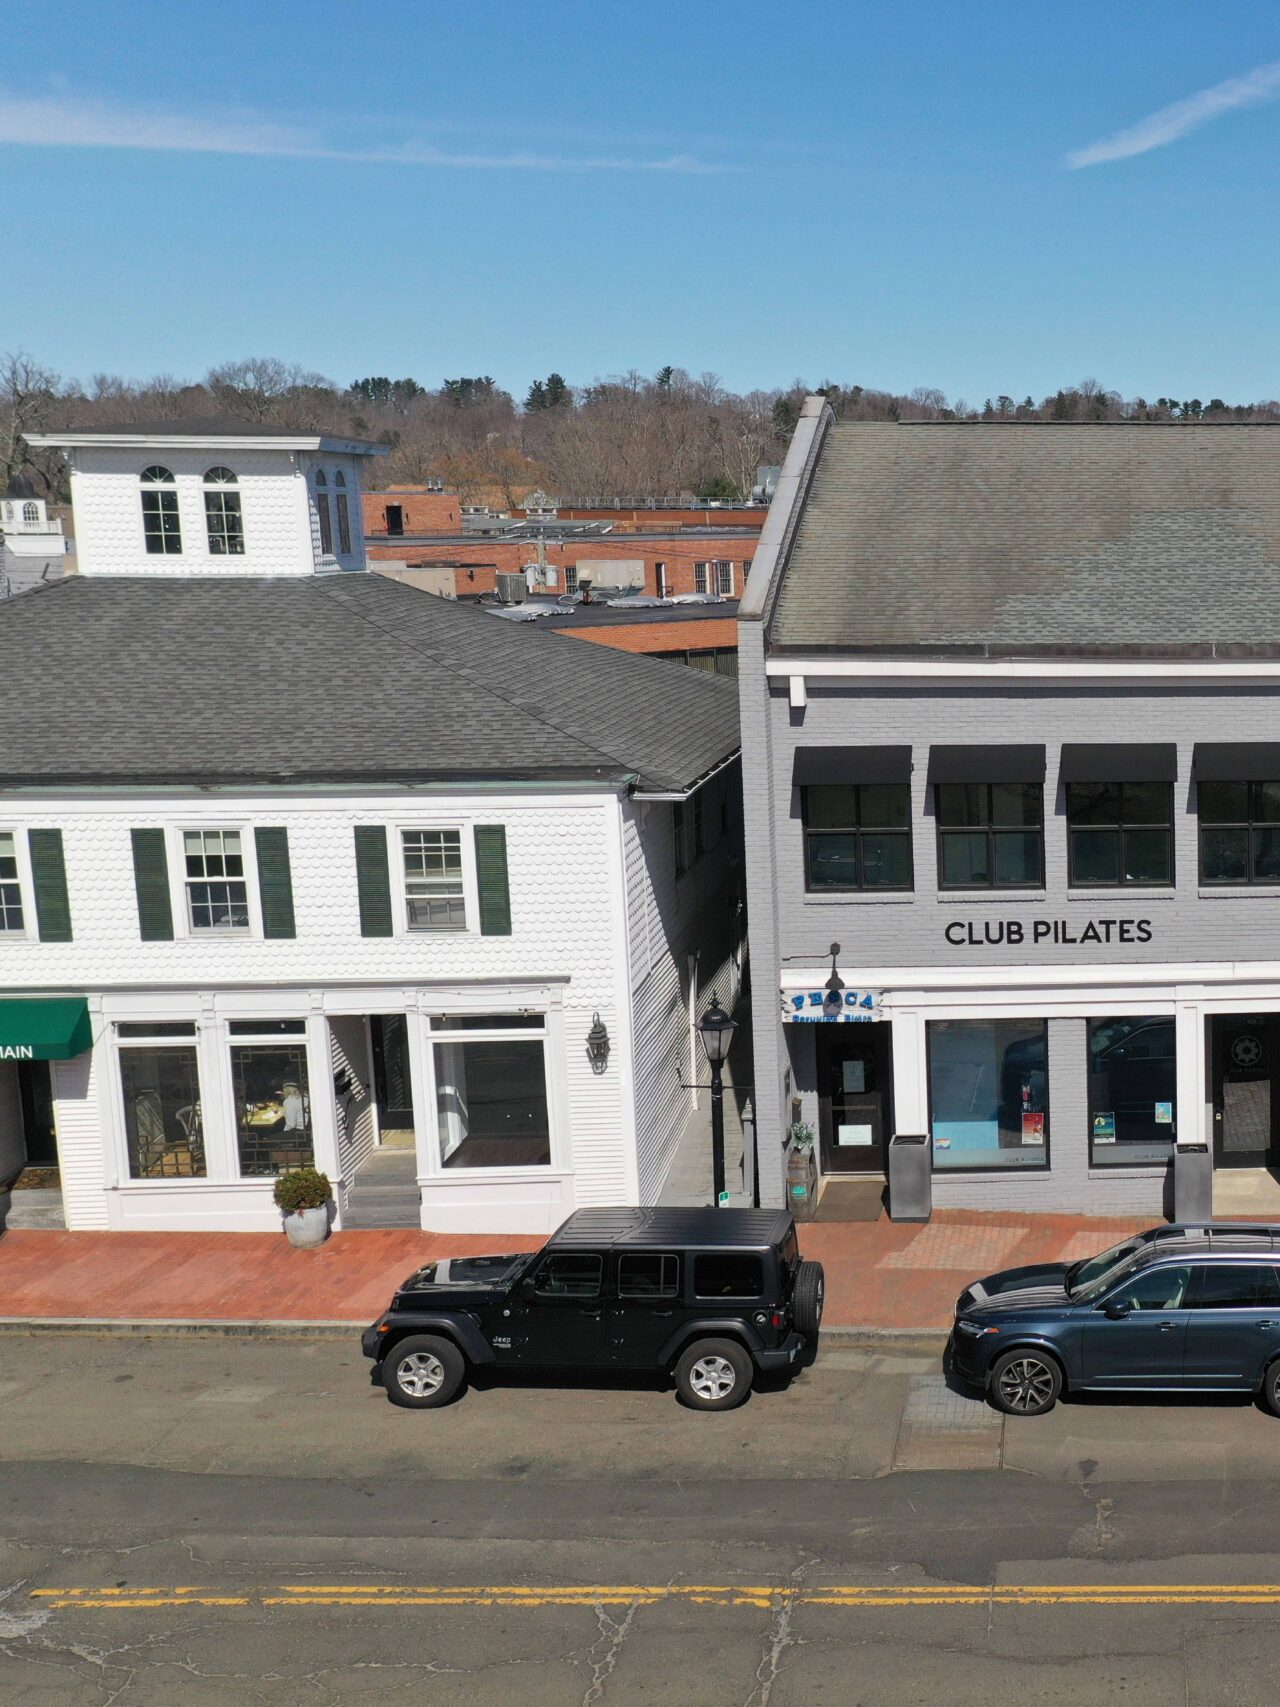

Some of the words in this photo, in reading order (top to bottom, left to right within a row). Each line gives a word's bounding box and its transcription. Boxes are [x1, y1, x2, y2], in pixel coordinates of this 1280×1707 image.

[944, 921, 1024, 945] CLUB
[1033, 920, 1153, 944] PILATES
[0, 1045, 33, 1059] AIN
[493, 1336, 511, 1344] Jeep
